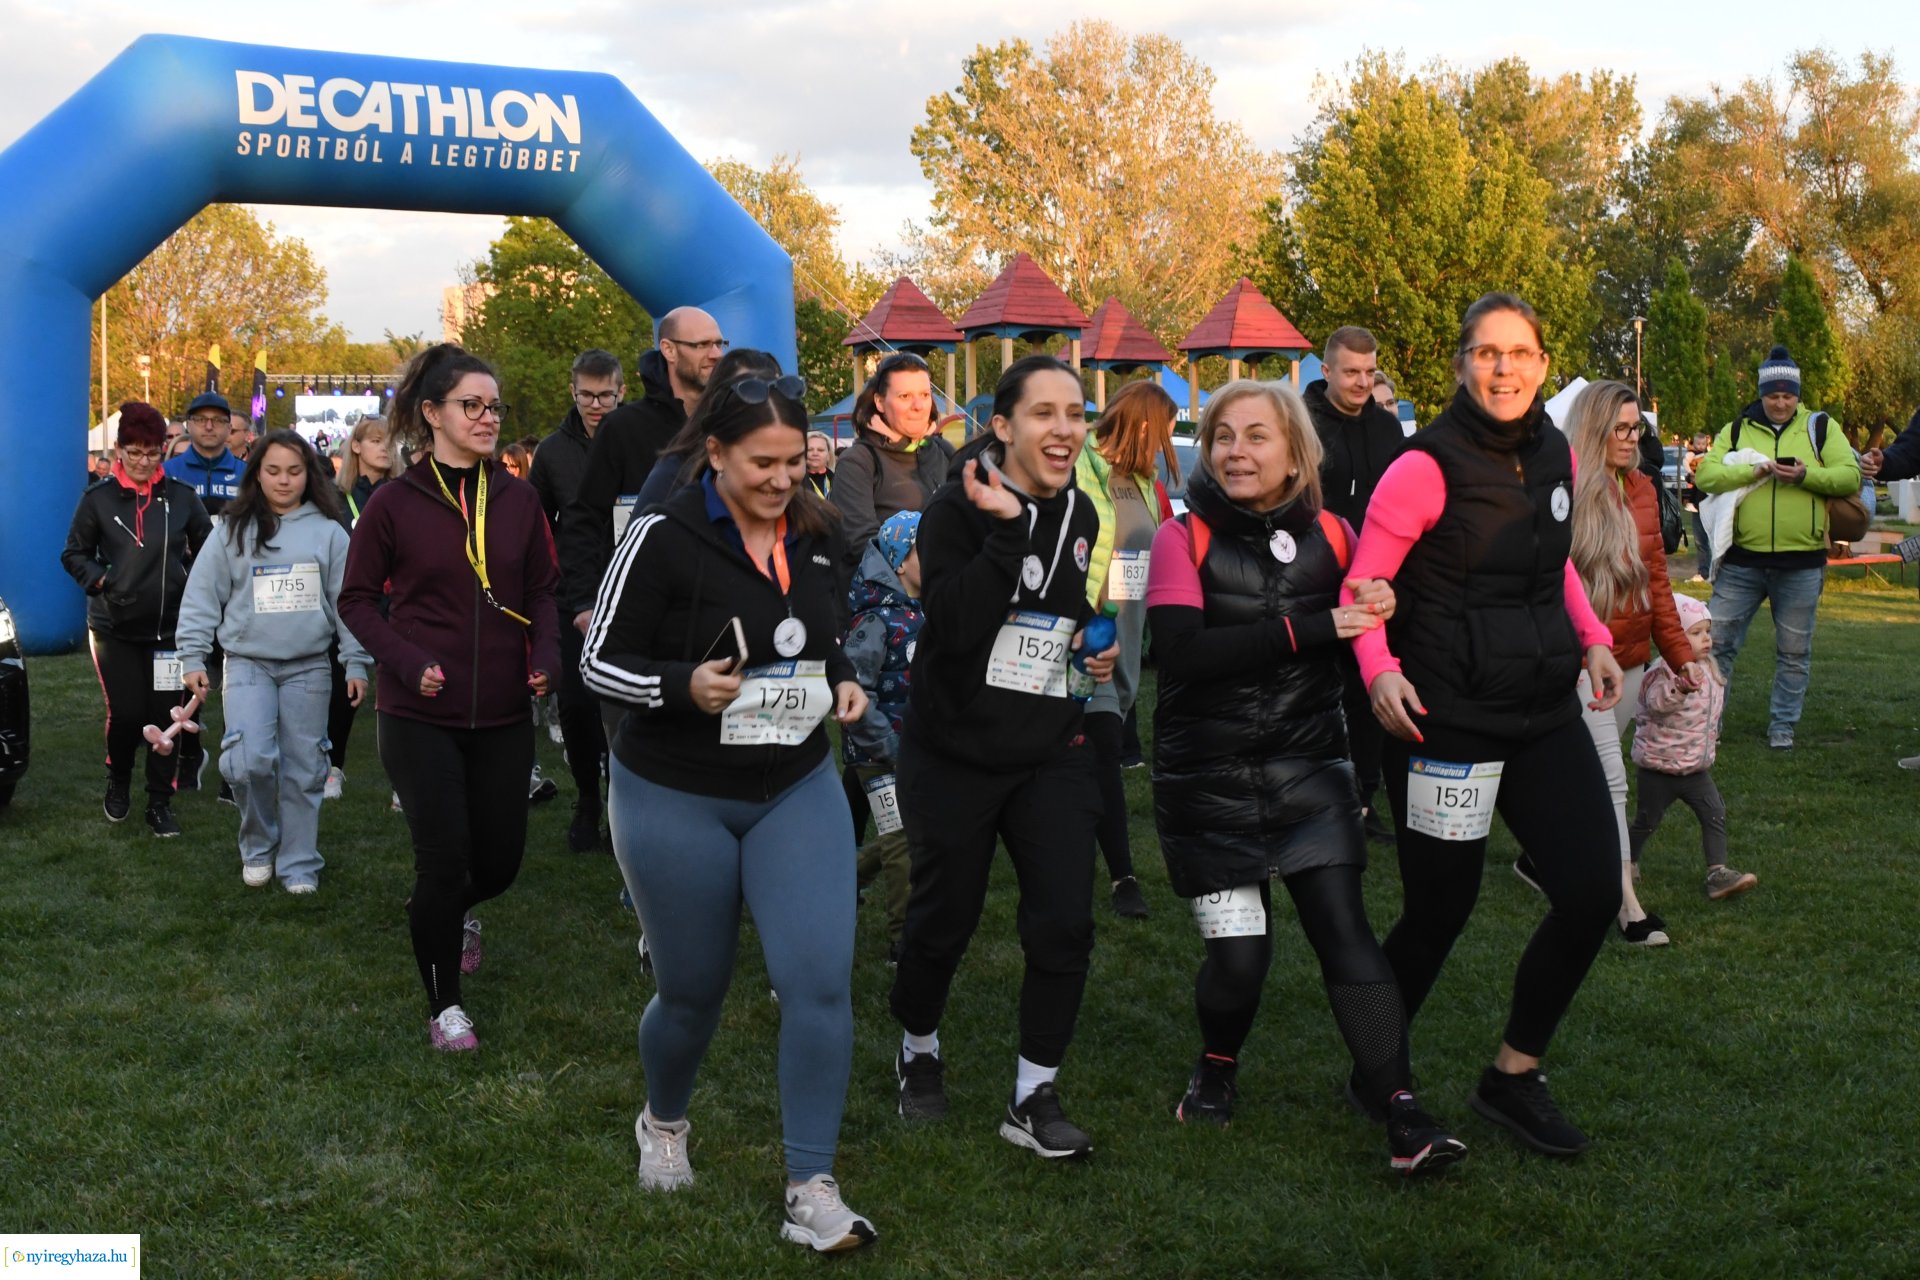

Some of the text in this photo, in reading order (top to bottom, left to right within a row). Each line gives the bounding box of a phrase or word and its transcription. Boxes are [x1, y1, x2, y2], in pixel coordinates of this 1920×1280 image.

[235, 70, 581, 144] DECATHLON
[237, 132, 581, 173] SPORTBÓL A LEGTÖBBET
[195, 484, 224, 496] NIKE
[1122, 565, 1145, 579] 1637
[270, 578, 305, 592] 1755
[1019, 635, 1064, 663] 1522
[760, 687, 807, 710] 1751
[1436, 786, 1479, 808] 1521
